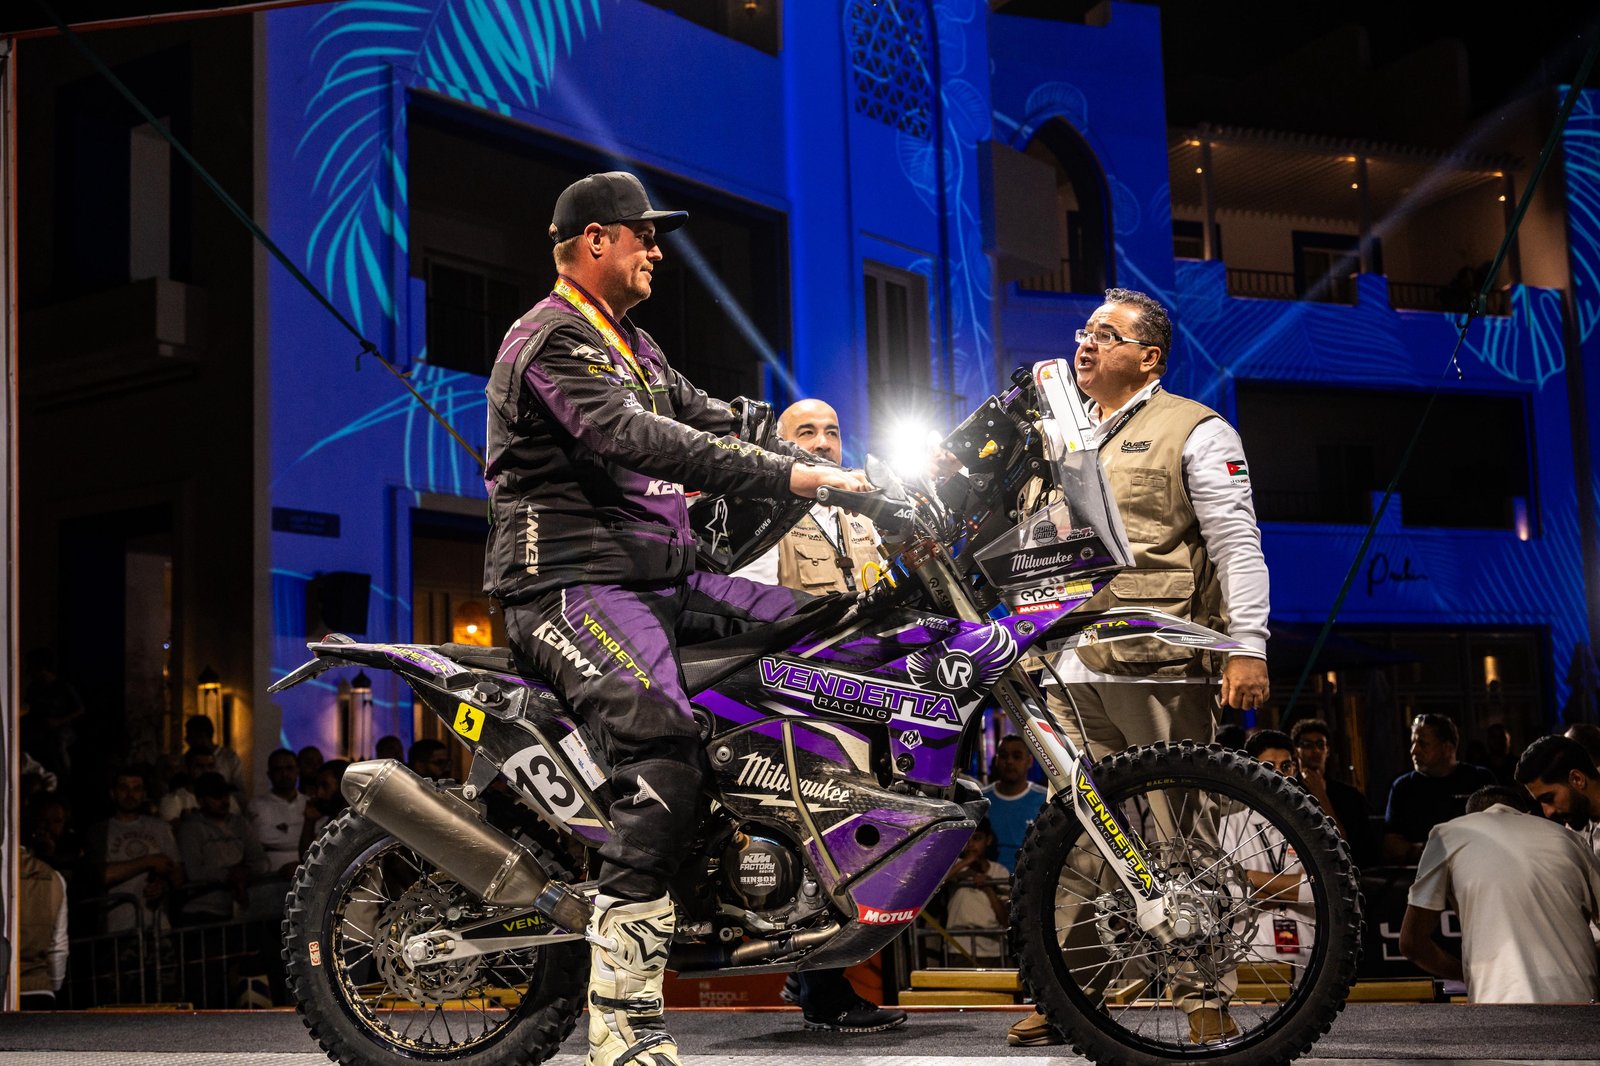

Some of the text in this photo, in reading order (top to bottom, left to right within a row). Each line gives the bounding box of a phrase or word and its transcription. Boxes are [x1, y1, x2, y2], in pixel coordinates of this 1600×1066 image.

[644, 480, 685, 496] KEN
[1011, 552, 1073, 572] Milwaukee
[1020, 586, 1055, 602] epc
[1019, 602, 1060, 613] MOTUL
[916, 618, 957, 634] HYGIENE
[532, 620, 603, 677] KENNY
[583, 613, 651, 690] VENDETTA
[939, 658, 970, 688] VR
[762, 660, 958, 721] VENDETTA
[818, 697, 888, 720] RACING
[515, 755, 576, 815] 13
[738, 751, 850, 802] Milwaukee
[1078, 774, 1153, 890] VENDETTA
[1093, 816, 1123, 859] RACING
[739, 862, 776, 871] FACTORY
[742, 852, 772, 864] KTM
[739, 875, 776, 883] HINSON
[863, 909, 914, 923] MOTUL
